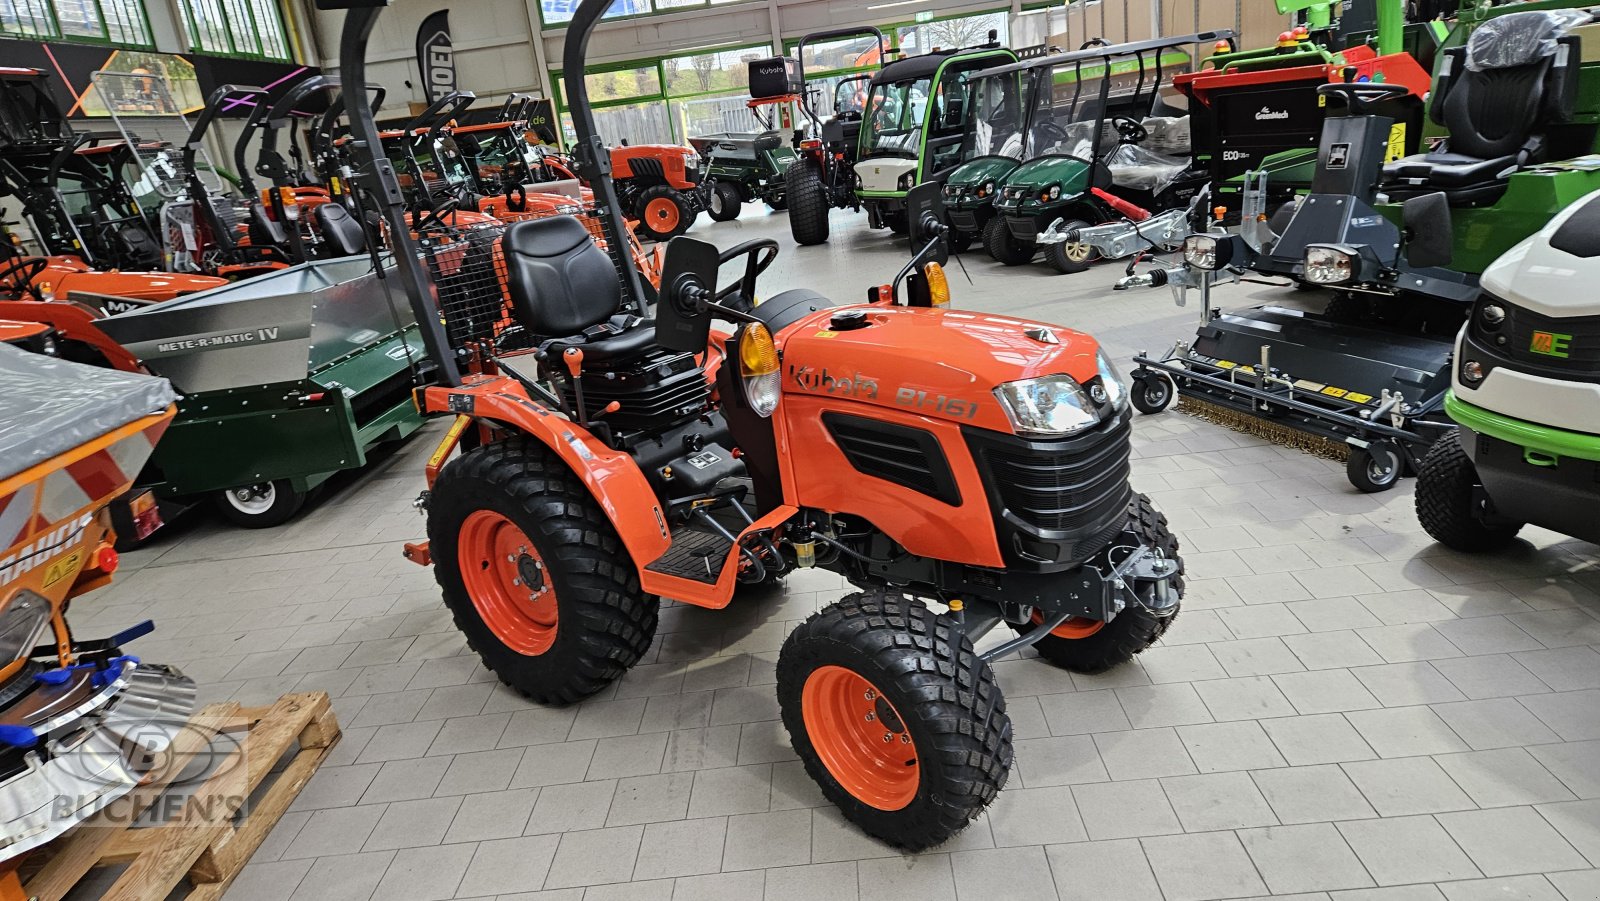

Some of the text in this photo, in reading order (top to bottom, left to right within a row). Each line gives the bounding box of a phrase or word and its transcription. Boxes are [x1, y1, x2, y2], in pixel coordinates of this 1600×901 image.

[759, 66, 784, 75] Kubota
[1222, 150, 1239, 161] ECO
[157, 326, 280, 353] METE-R-MATIC IV
[789, 364, 979, 419] Kubota B1-161
